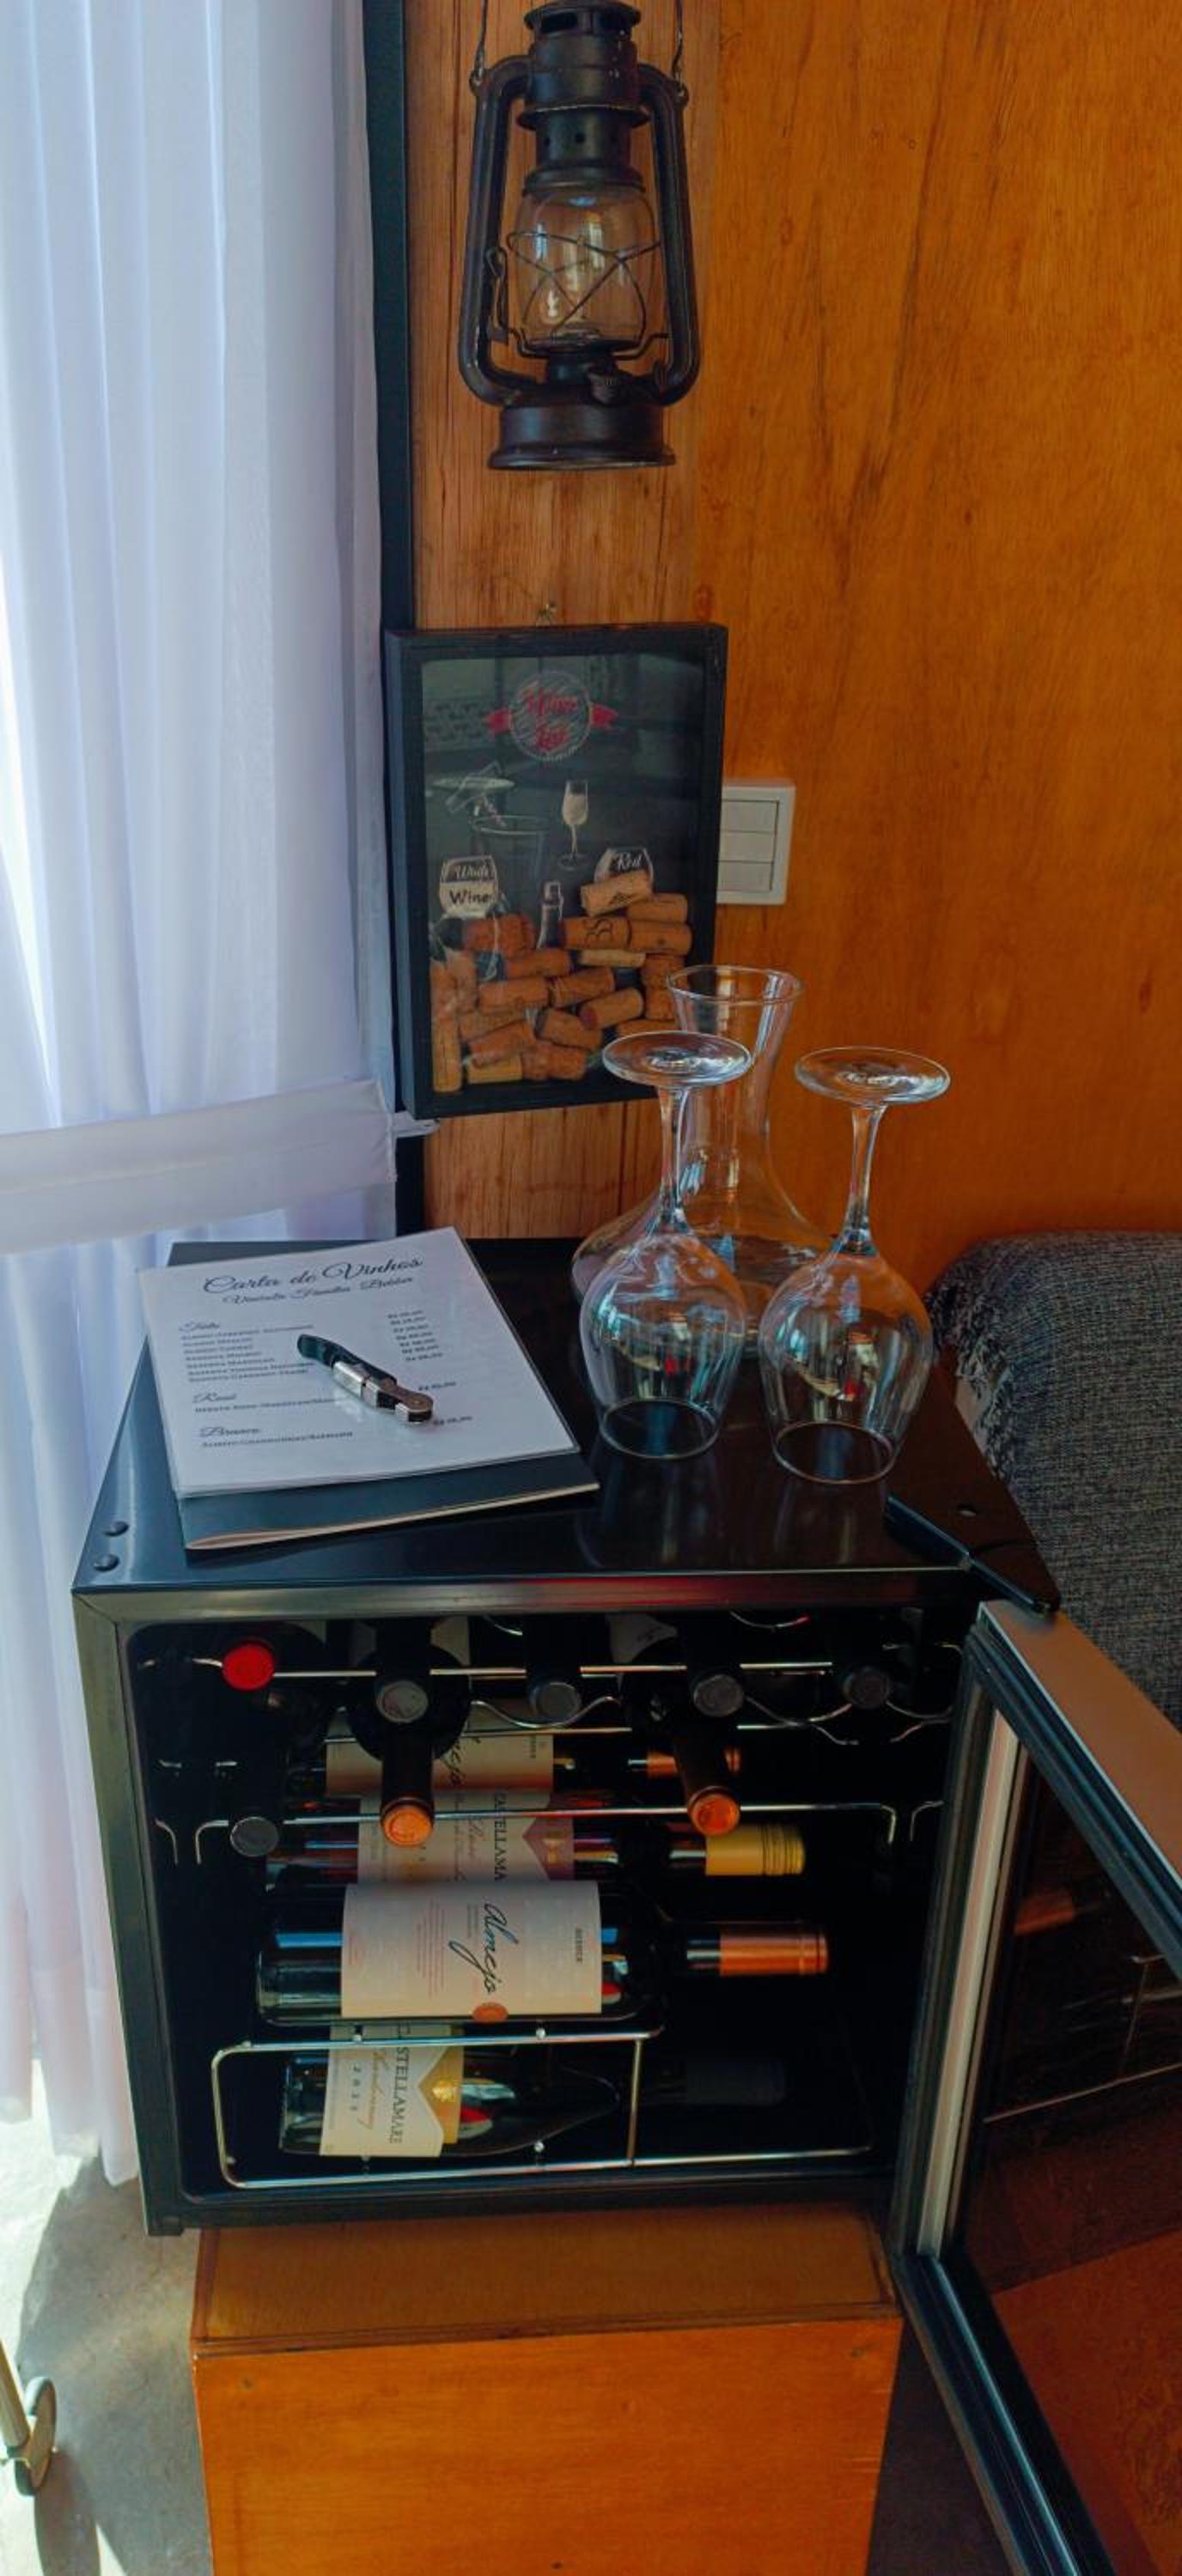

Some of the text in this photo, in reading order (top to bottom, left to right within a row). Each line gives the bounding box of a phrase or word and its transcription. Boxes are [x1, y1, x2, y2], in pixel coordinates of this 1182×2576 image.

[617, 851, 643, 871] Red
[448, 889, 490, 904] Wine
[204, 1258, 423, 1293] Carta de Vinhos
[388, 2022, 411, 2145] CSTELLAMARE
